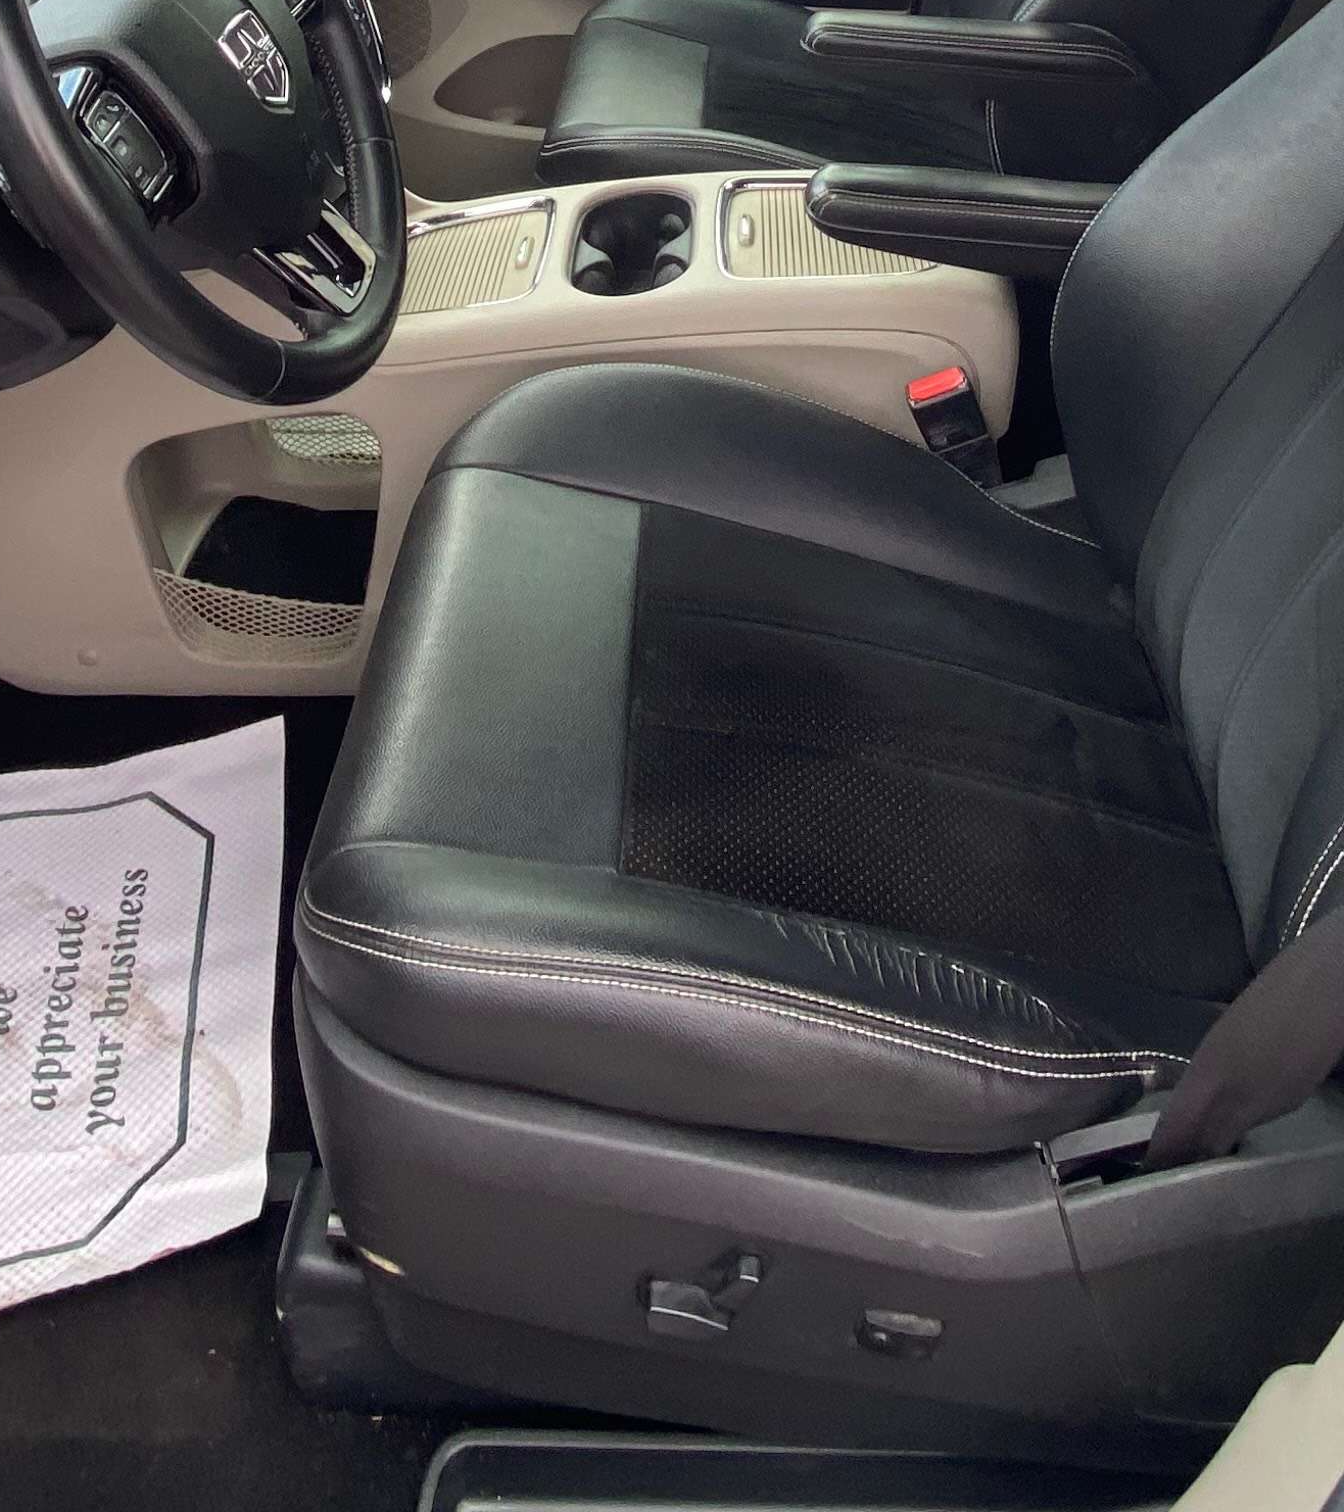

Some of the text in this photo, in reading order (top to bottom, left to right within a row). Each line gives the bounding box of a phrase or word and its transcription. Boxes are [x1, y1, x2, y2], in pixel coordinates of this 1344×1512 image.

[30, 904, 89, 1112] appreciate
[84, 867, 149, 1136] your business
